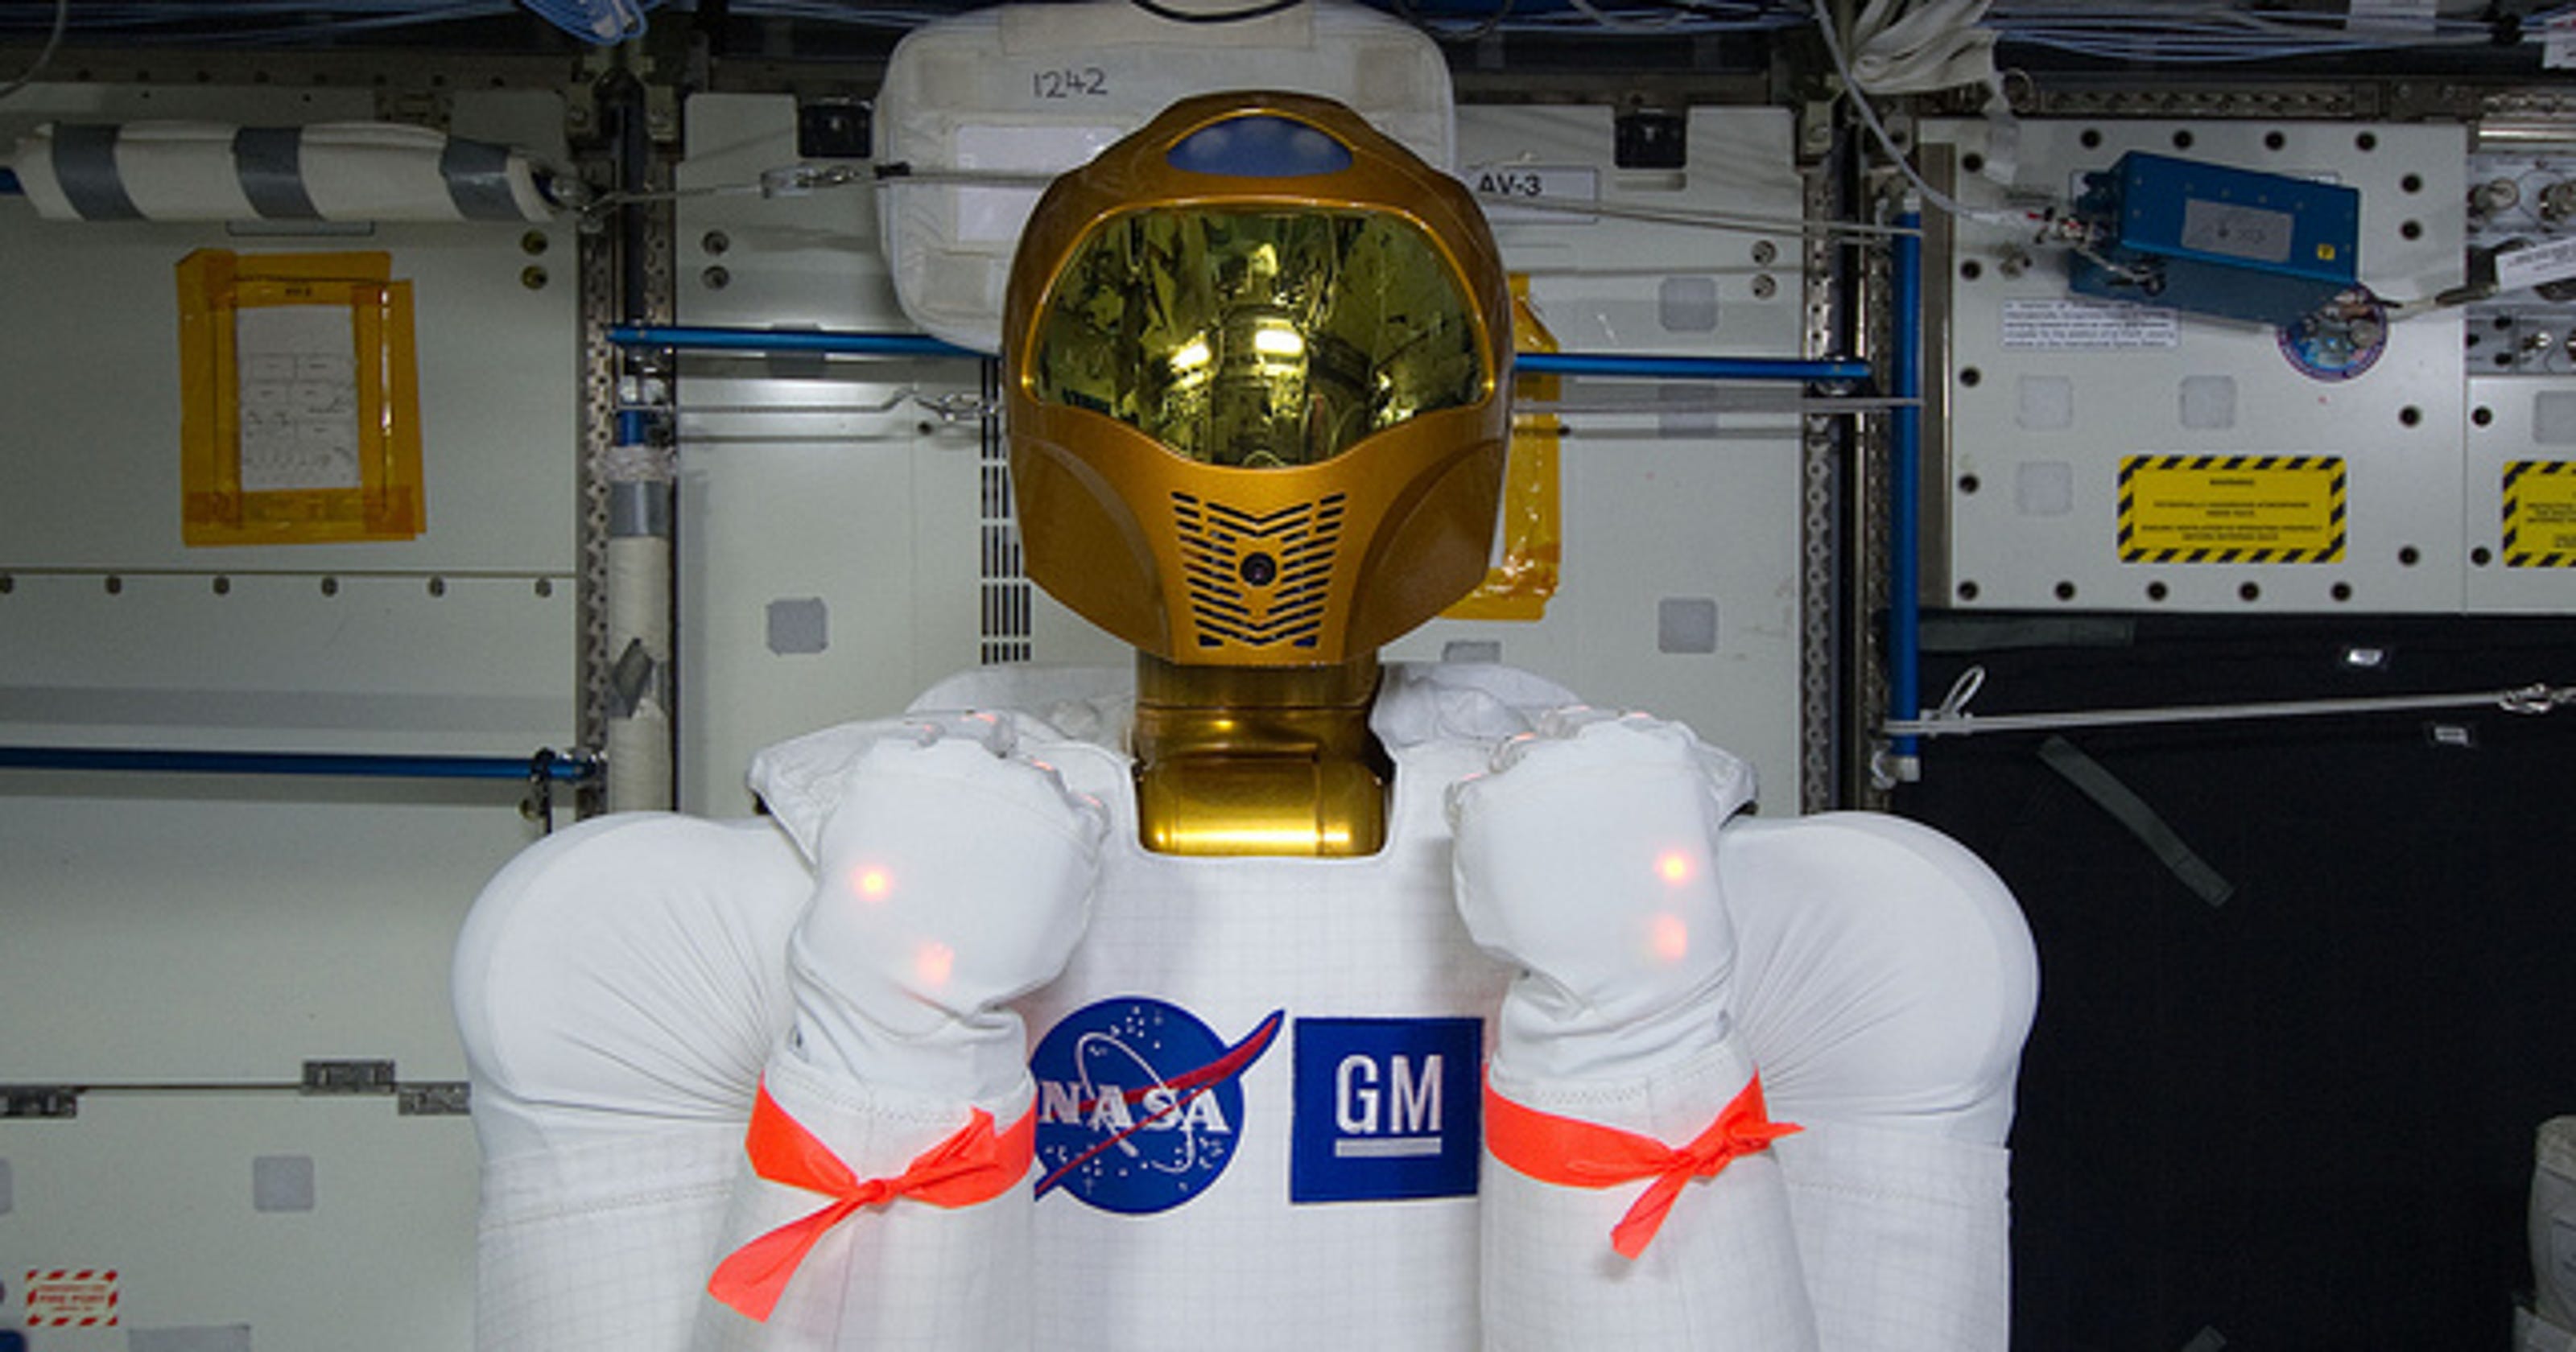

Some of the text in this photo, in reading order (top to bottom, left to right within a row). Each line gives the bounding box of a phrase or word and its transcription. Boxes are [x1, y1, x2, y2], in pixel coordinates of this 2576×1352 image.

[1033, 67, 1108, 98] 1242
[1041, 1081, 1231, 1132] NASA
[1335, 1054, 1443, 1133] GM
